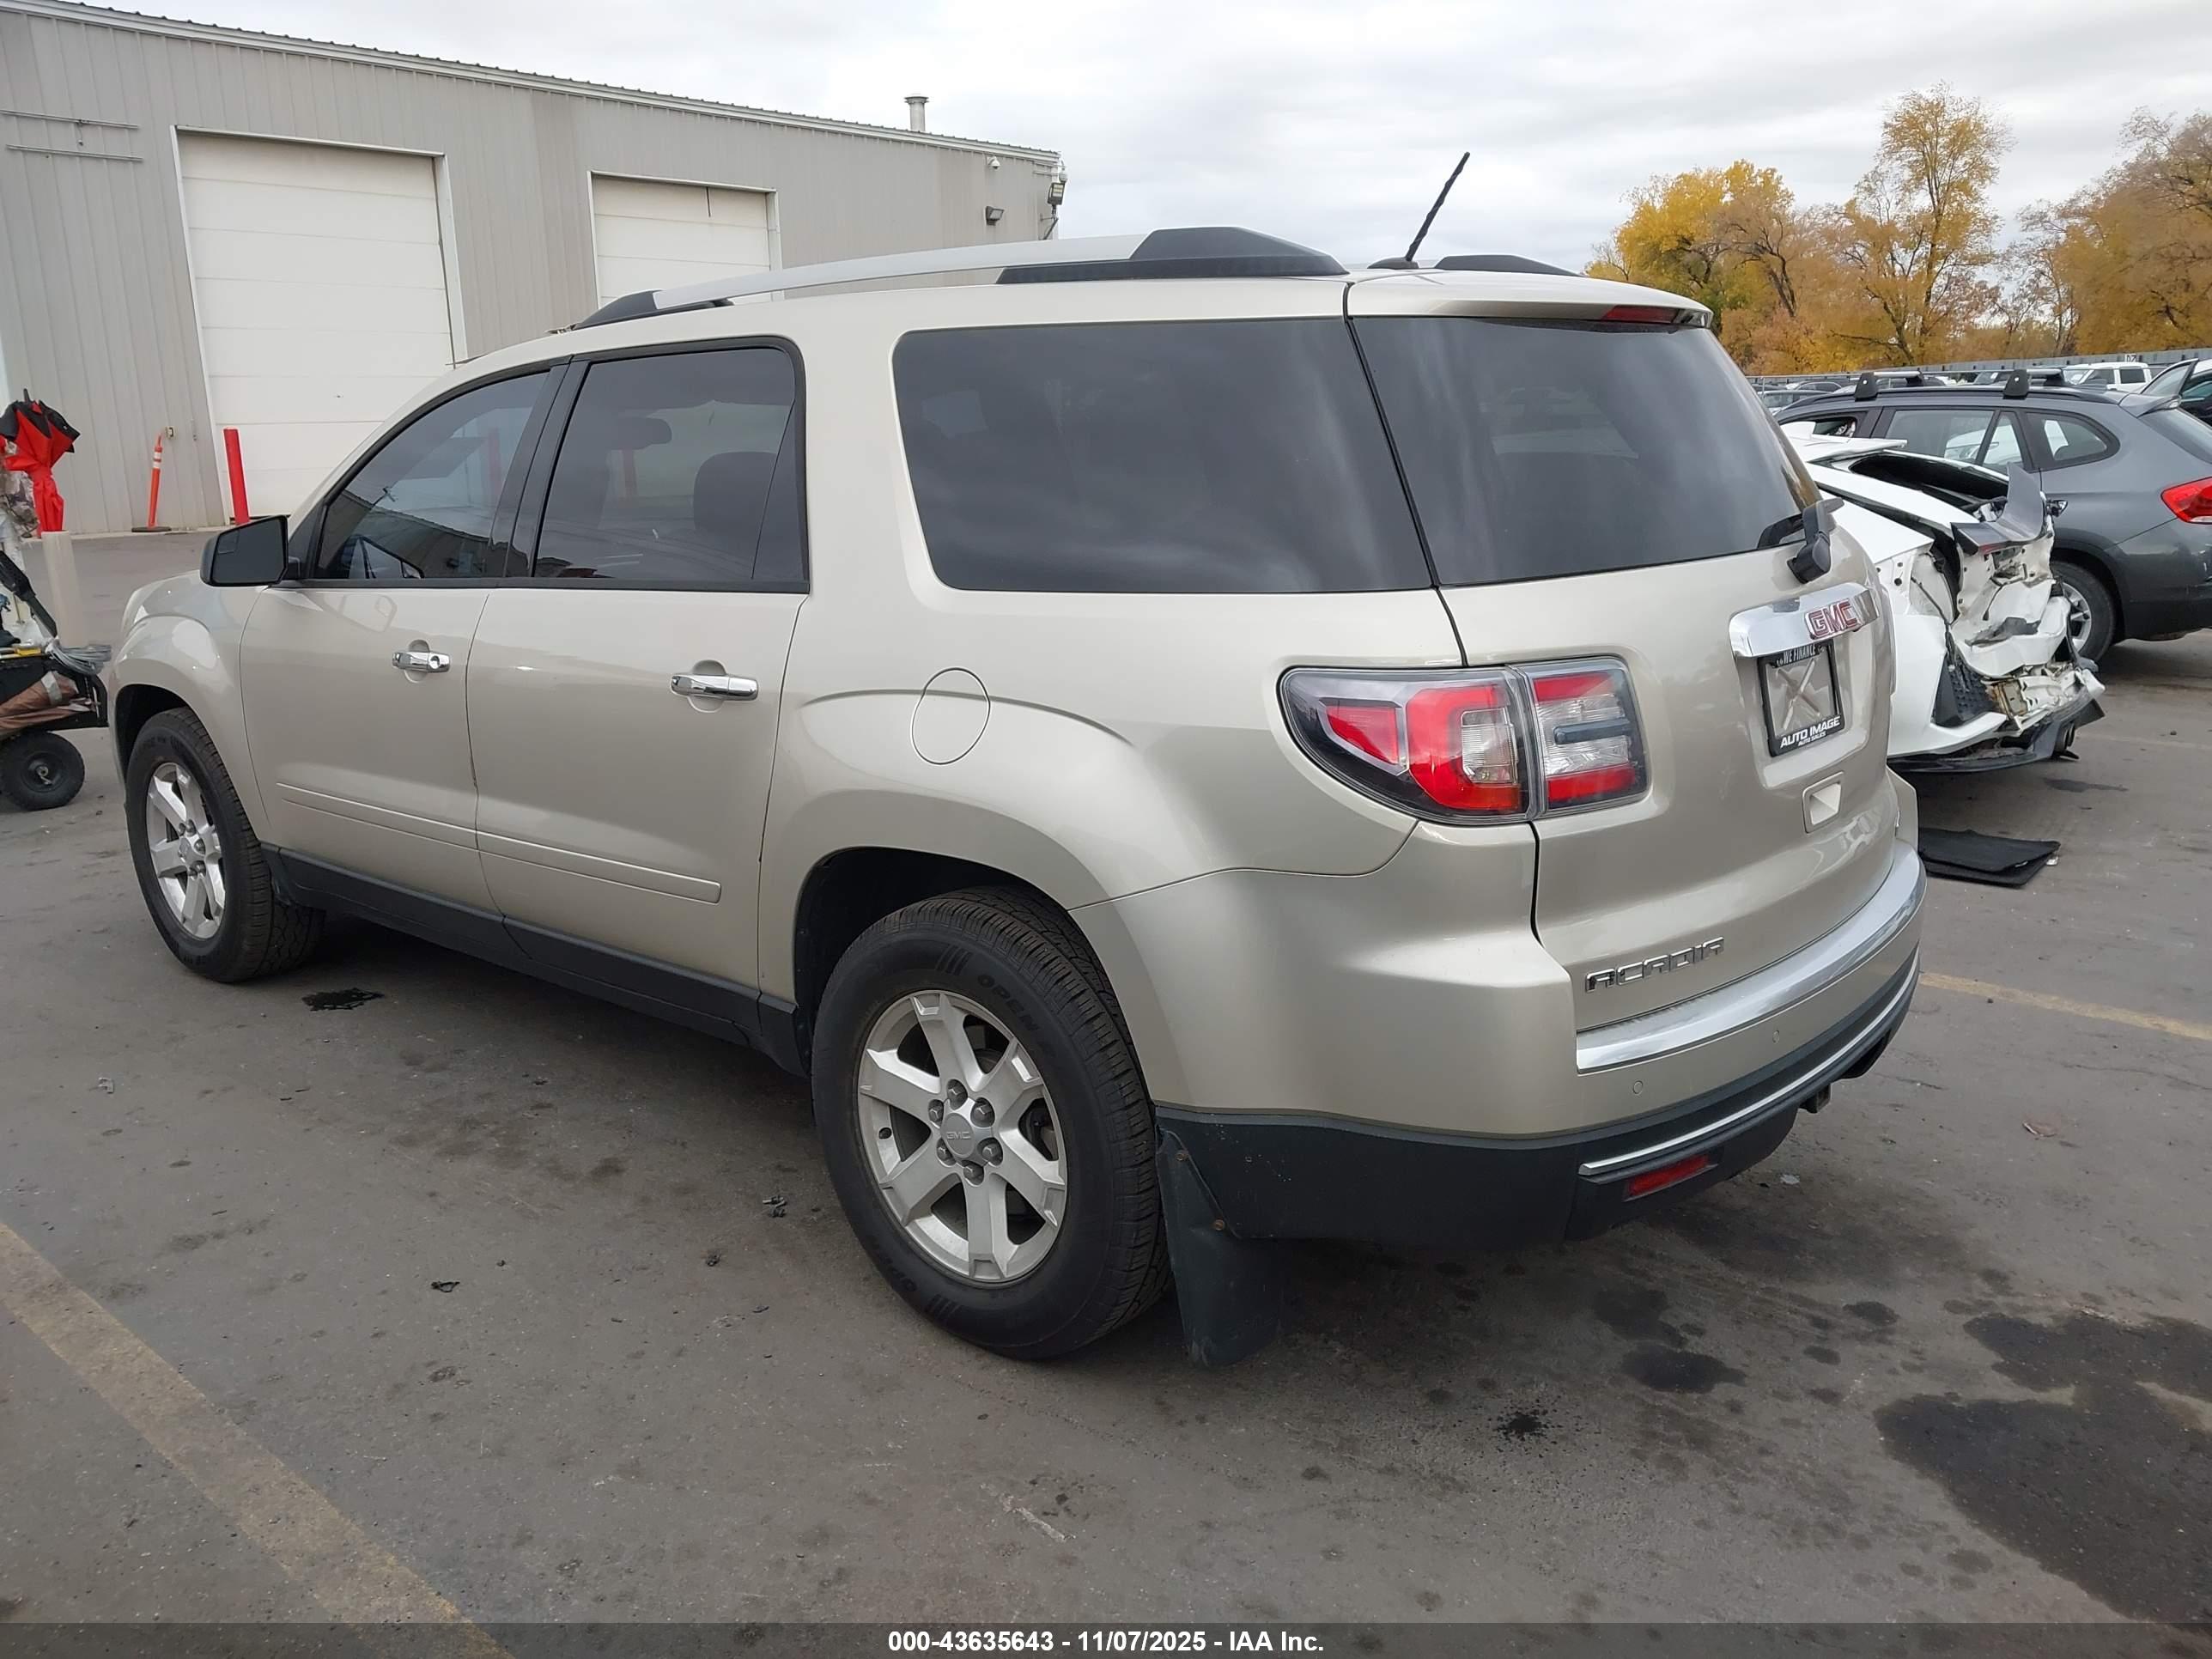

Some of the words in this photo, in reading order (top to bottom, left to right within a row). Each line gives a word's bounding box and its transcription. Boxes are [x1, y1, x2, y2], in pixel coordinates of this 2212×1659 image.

[1806, 599, 1858, 637] GMC
[1783, 651, 1793, 664] WE
[1794, 643, 1816, 661] FINANCE
[1780, 728, 1808, 749] AUTO
[1809, 715, 1840, 737] IMAGE
[1797, 737, 1811, 747] AUTO
[1585, 936, 1724, 993] ACADIA
[946, 1131, 972, 1140] GMC
